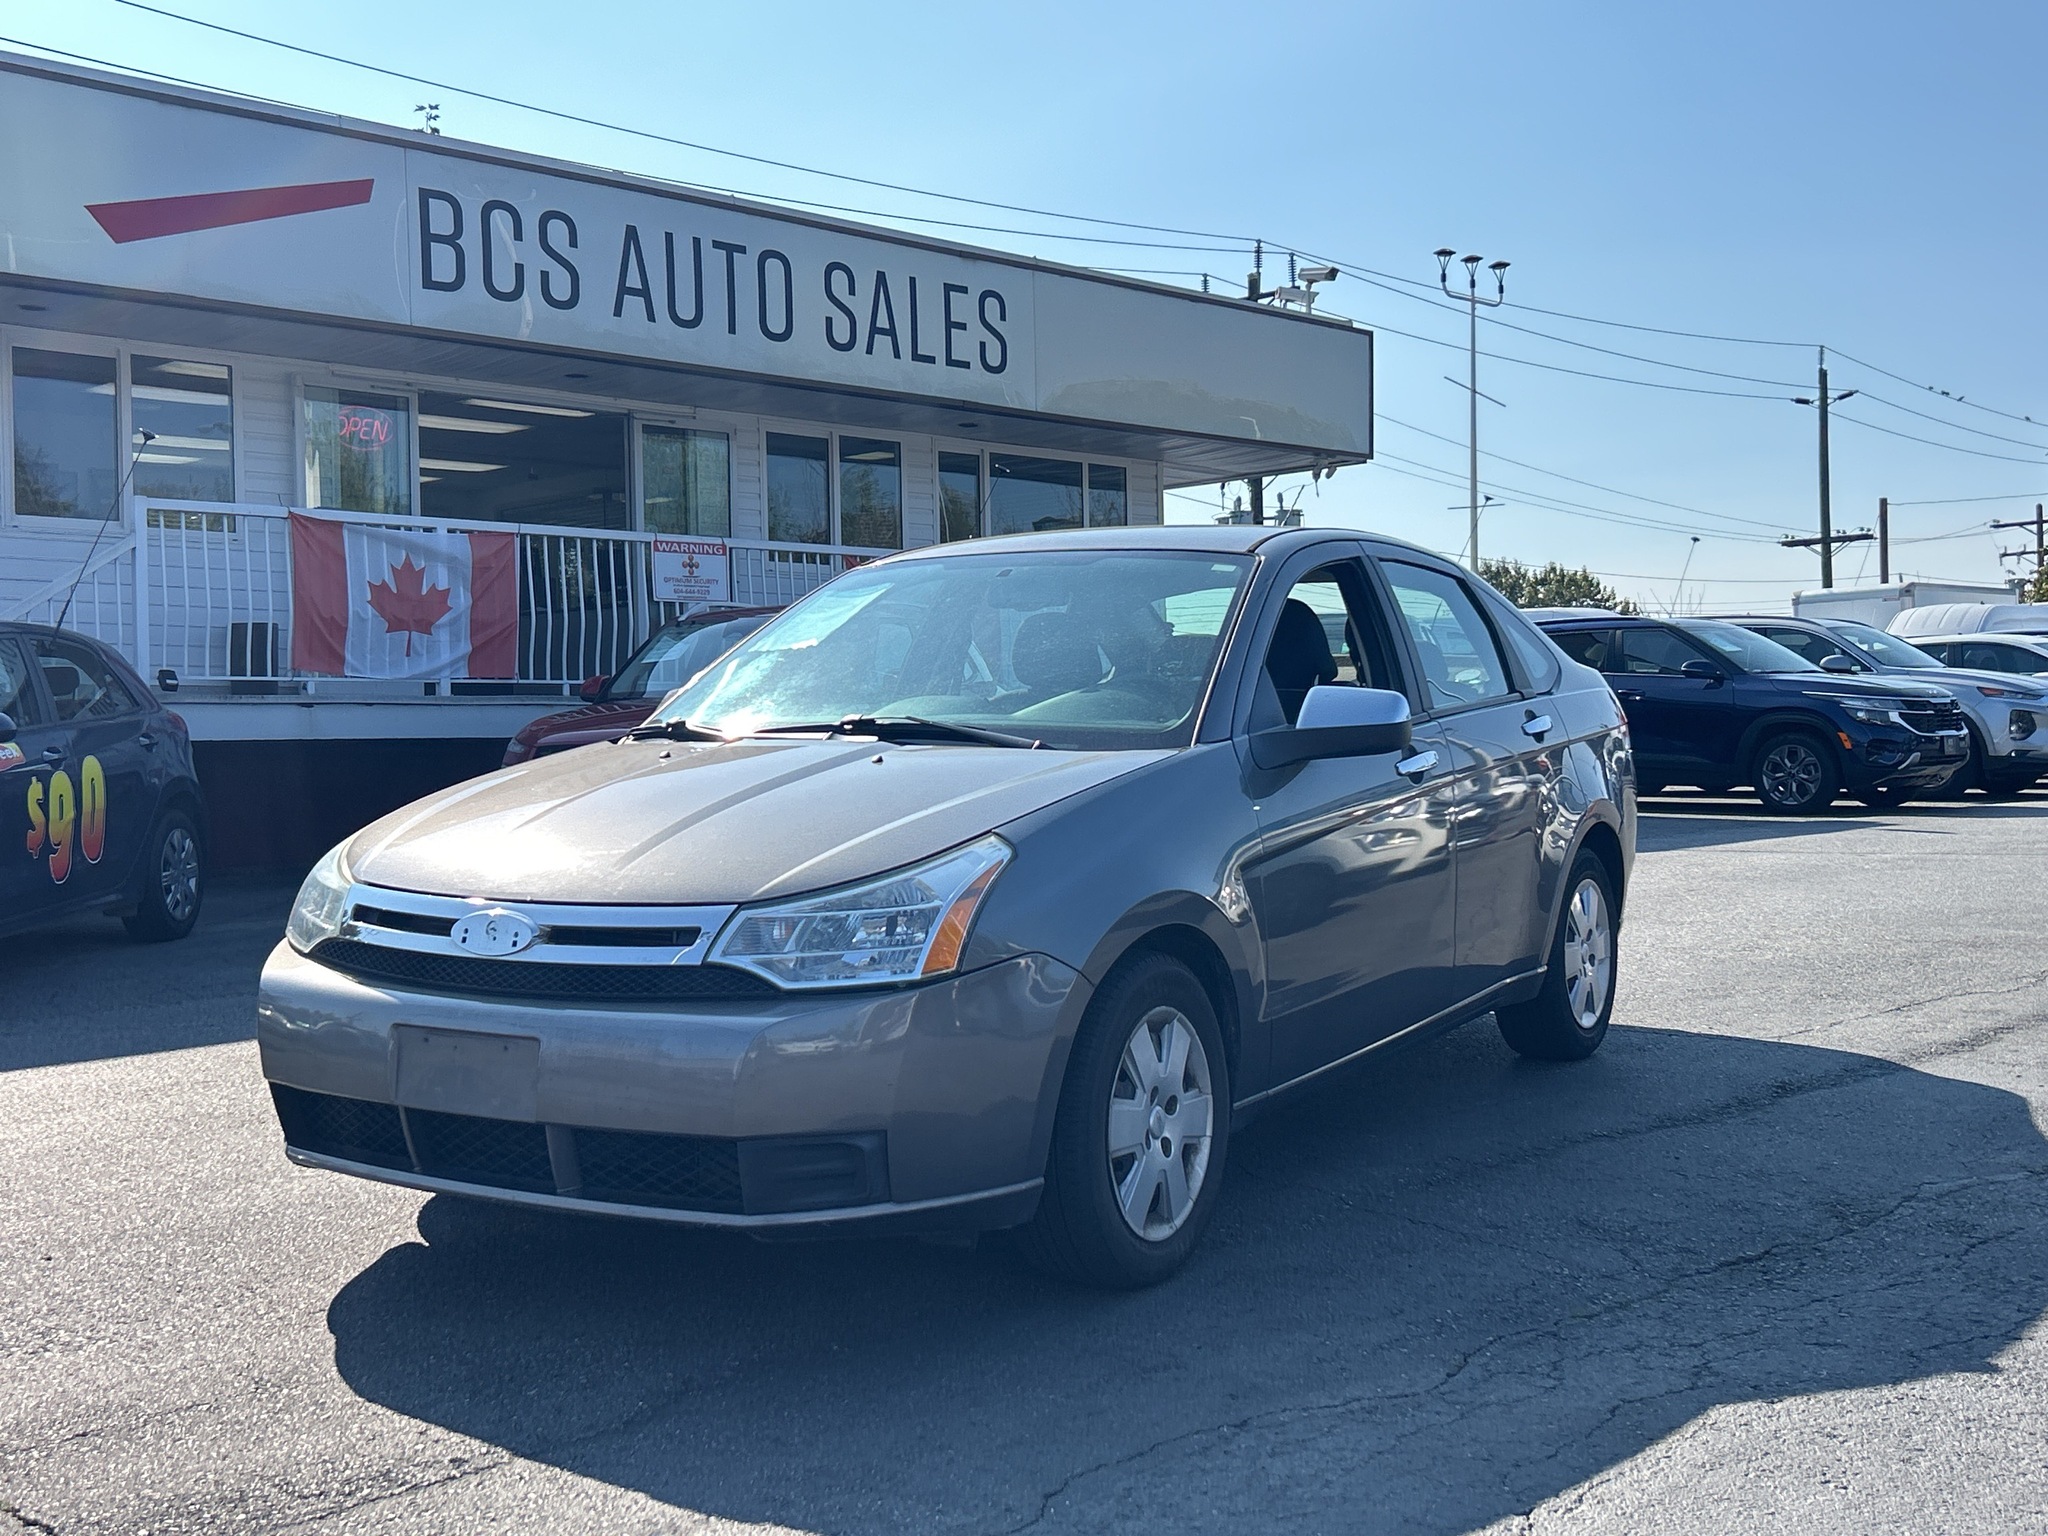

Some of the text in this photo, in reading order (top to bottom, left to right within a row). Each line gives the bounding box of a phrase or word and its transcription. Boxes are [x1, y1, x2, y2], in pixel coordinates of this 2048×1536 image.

[418, 187, 1009, 374] BCS AUTO SALES
[338, 415, 389, 441] OPEN
[656, 541, 724, 555] WARNING
[663, 576, 719, 586] OPTIMUM SECURITY
[0, 747, 21, 760] eek
[27, 754, 107, 885] $90
